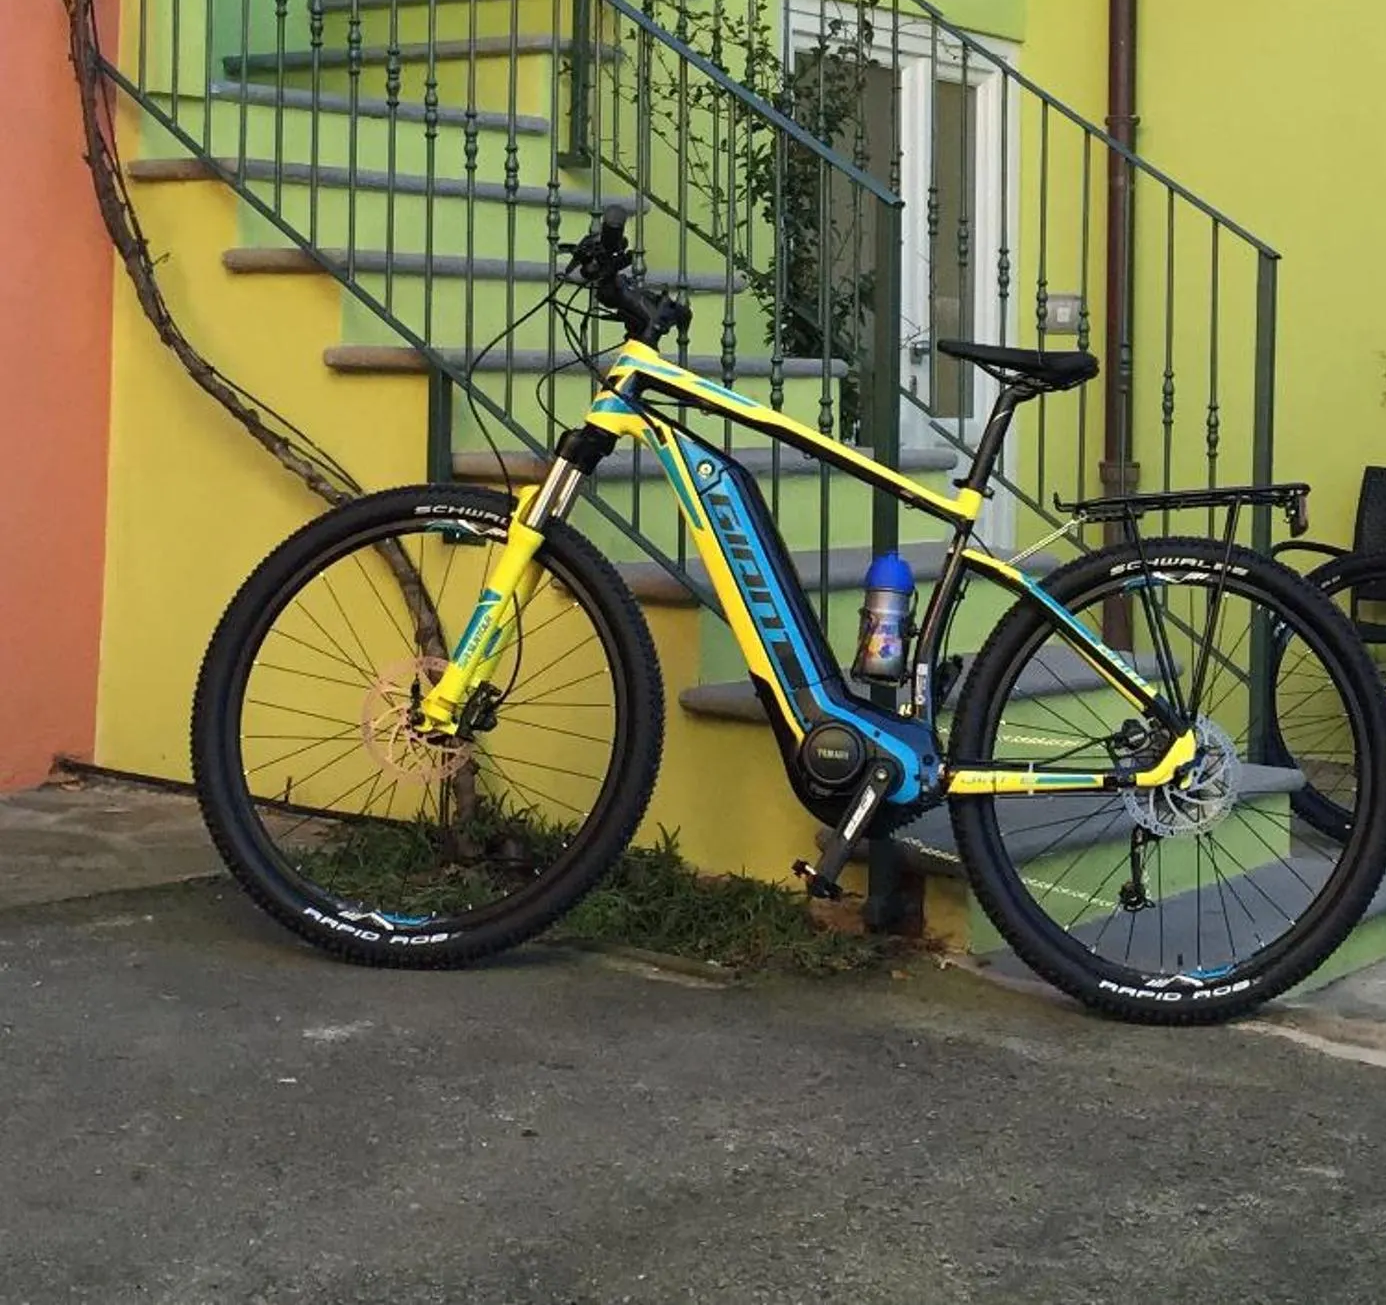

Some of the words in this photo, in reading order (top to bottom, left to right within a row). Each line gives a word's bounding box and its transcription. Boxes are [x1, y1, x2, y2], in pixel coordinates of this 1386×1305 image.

[414, 504, 509, 528] SCHWAL
[302, 906, 382, 942] RAPID
[388, 932, 450, 946] ROB
[1098, 979, 1183, 1002] RAPID
[1192, 978, 1251, 1000] ROB
